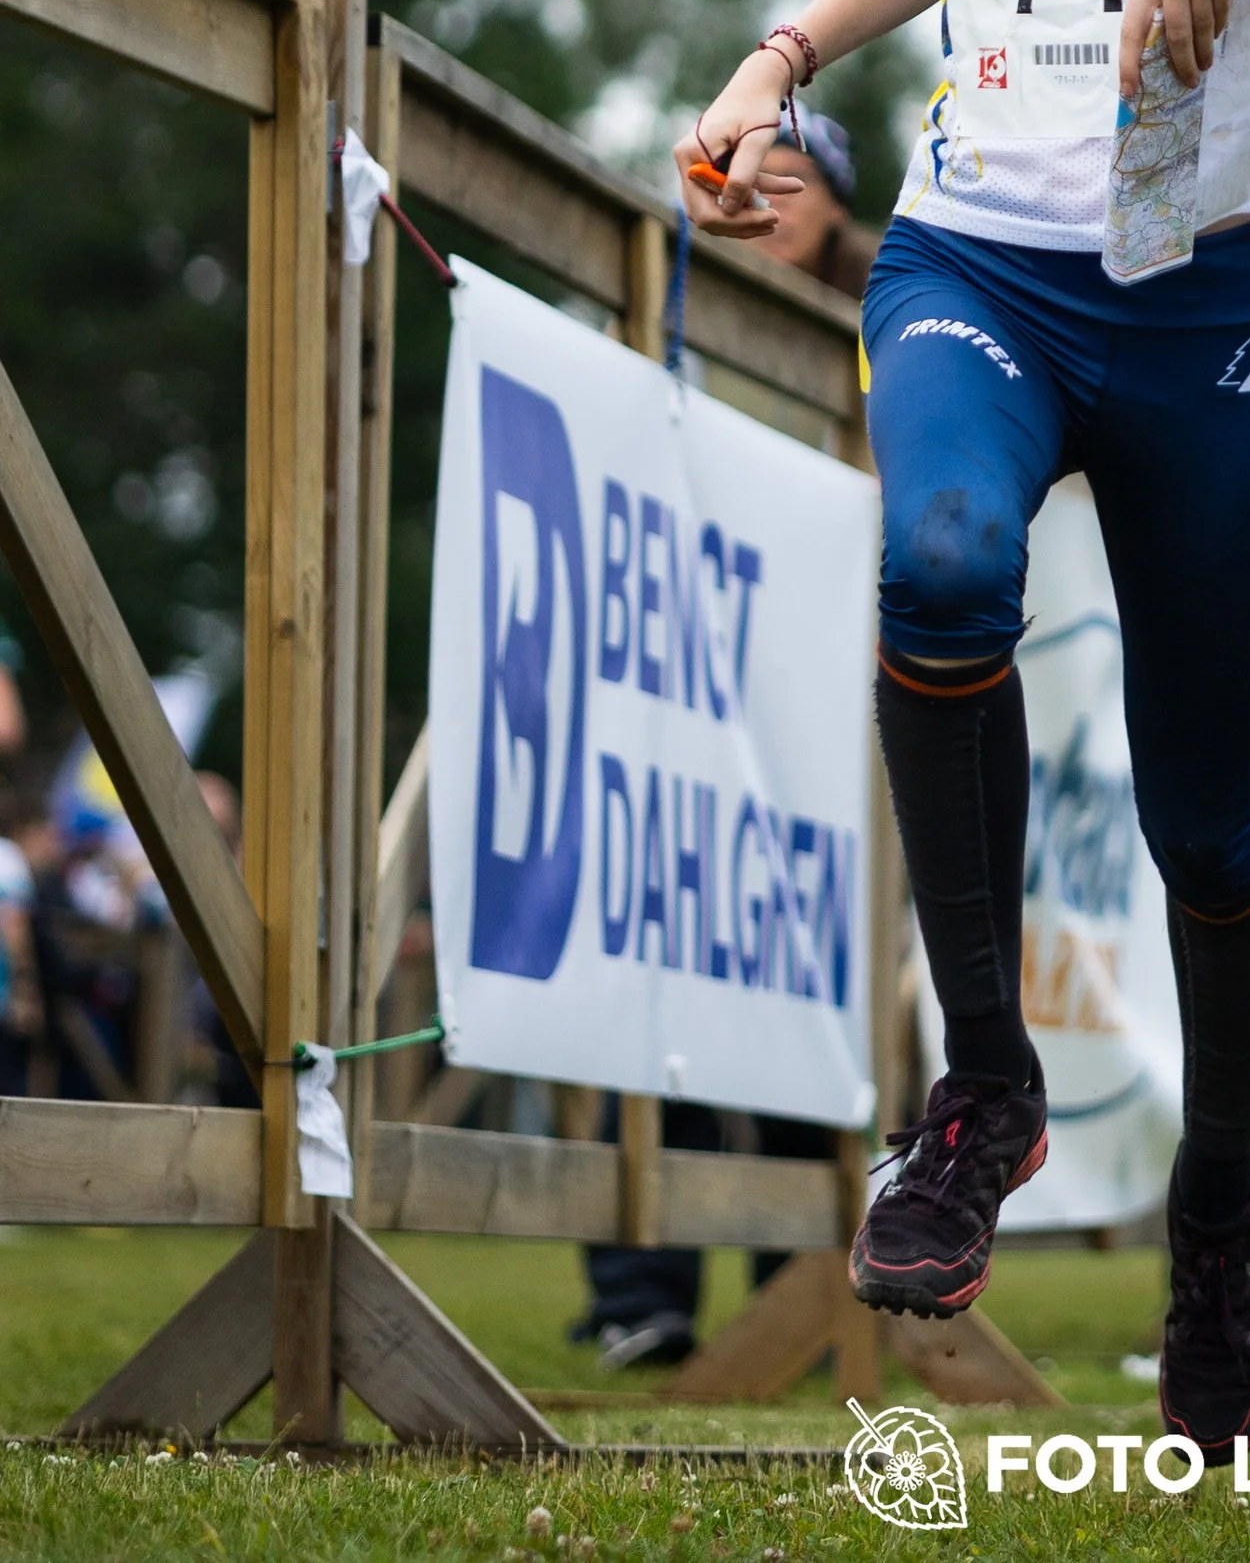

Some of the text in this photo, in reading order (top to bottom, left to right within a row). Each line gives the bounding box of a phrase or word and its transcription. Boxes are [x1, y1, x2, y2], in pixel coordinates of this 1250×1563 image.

[898, 318, 1023, 380] TRIMTEX
[598, 473, 764, 723] BENGT
[598, 748, 857, 1011] DAHLGREN
